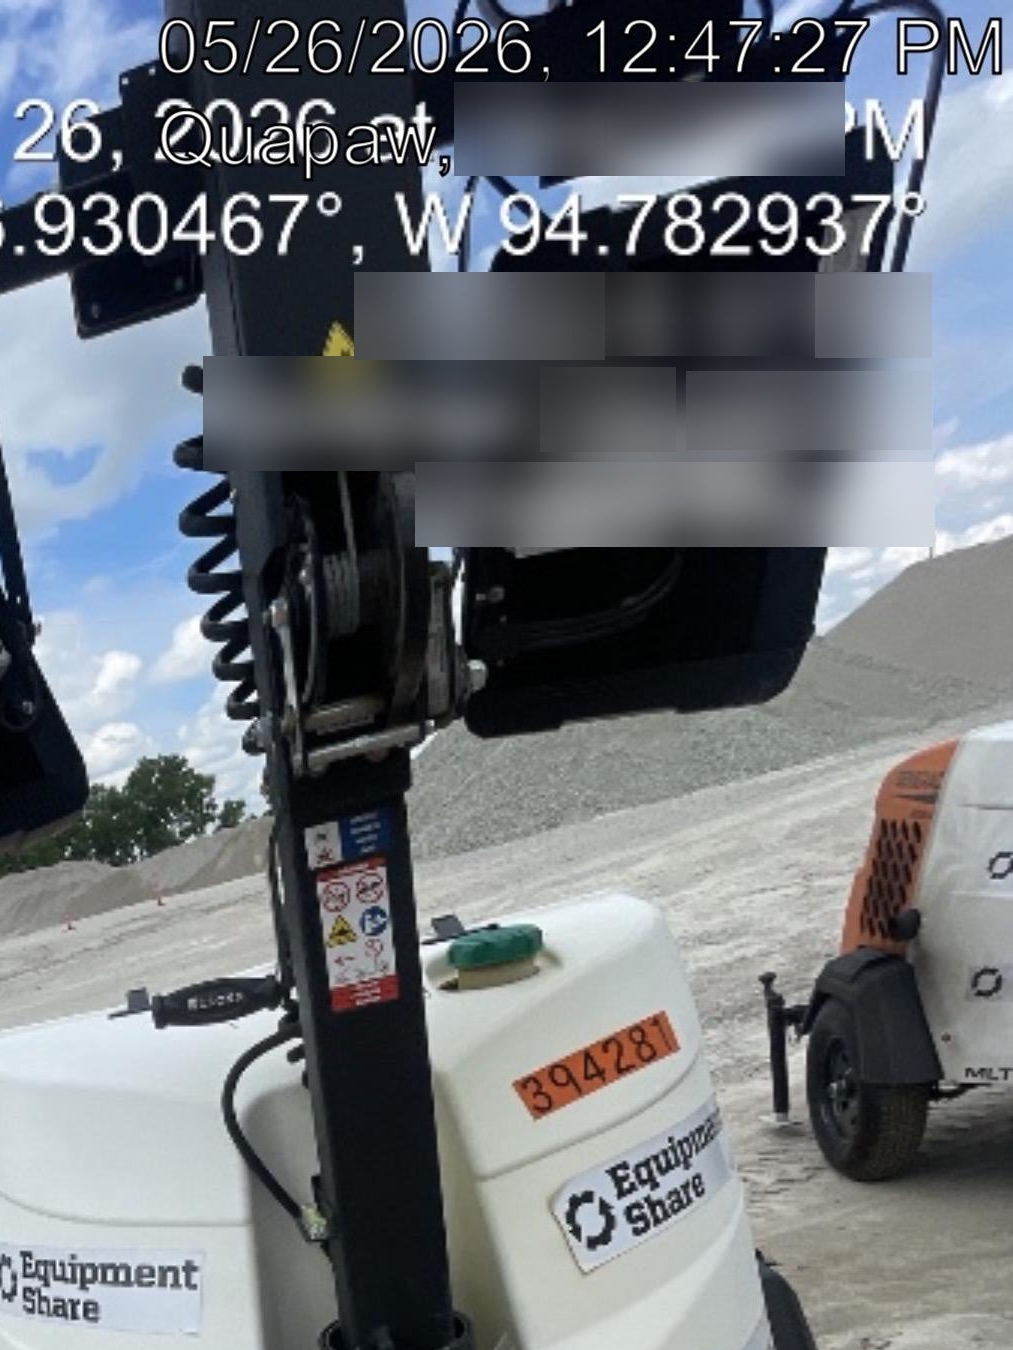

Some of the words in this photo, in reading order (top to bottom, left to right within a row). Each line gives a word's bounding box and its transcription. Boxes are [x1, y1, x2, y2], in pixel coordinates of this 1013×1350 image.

[521, 1017, 675, 1114] 394281
[622, 1172, 706, 1238] Share
[19, 1250, 200, 1291] Equipment
[21, 1286, 100, 1324] Share
